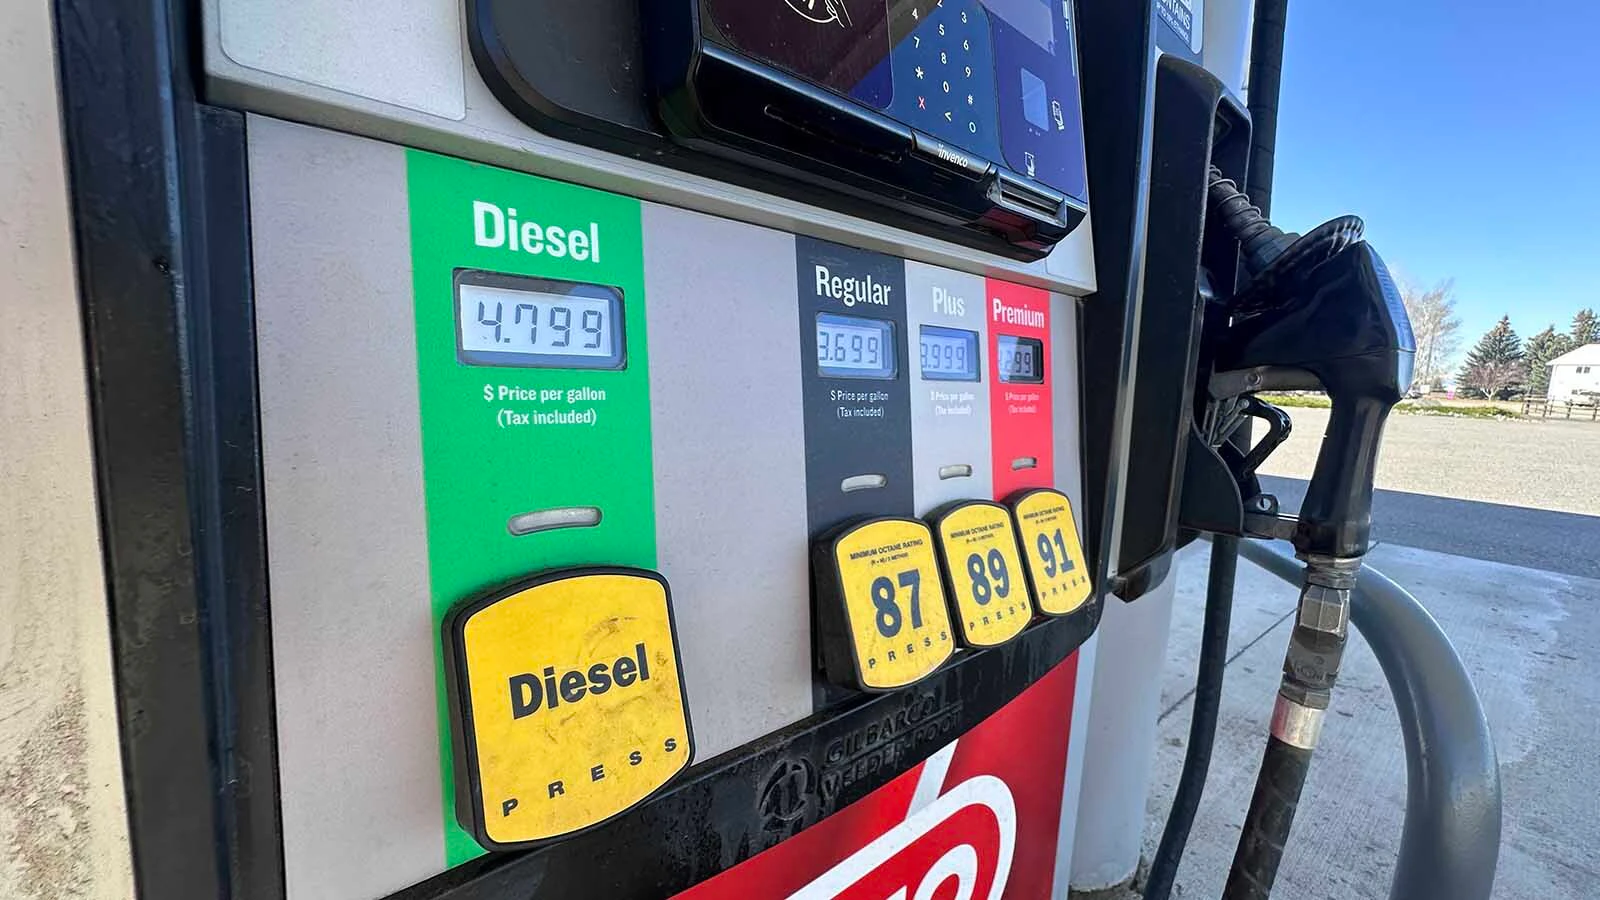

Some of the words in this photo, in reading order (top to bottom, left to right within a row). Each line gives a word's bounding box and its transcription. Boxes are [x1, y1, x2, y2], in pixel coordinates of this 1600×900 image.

[911, 7, 919, 19] 4
[938, 23, 945, 36] 5
[963, 39, 969, 51] 6
[960, 11, 967, 24] 3
[913, 36, 920, 48] 7
[940, 52, 947, 64] 8
[965, 66, 971, 78] 9
[473, 200, 601, 264] Diesel
[815, 265, 891, 307] Regular
[932, 286, 966, 317] Plus
[478, 301, 602, 349] 4.799
[992, 298, 1045, 328] Premium
[818, 331, 879, 364] 3.699
[483, 384, 494, 402] $
[498, 385, 537, 401] Price
[540, 389, 564, 404] per
[566, 386, 606, 404] gallon
[837, 390, 856, 401] Price
[837, 406, 852, 419] (Tax
[498, 408, 530, 429] (Tax
[533, 408, 597, 427] included)
[878, 543, 902, 554] OCTANE
[1037, 528, 1075, 578] 91
[967, 548, 1010, 606] 89
[871, 568, 923, 638] 87
[868, 631, 947, 669] PRESS
[509, 642, 650, 720] Diesel
[502, 738, 677, 817] PRESS
